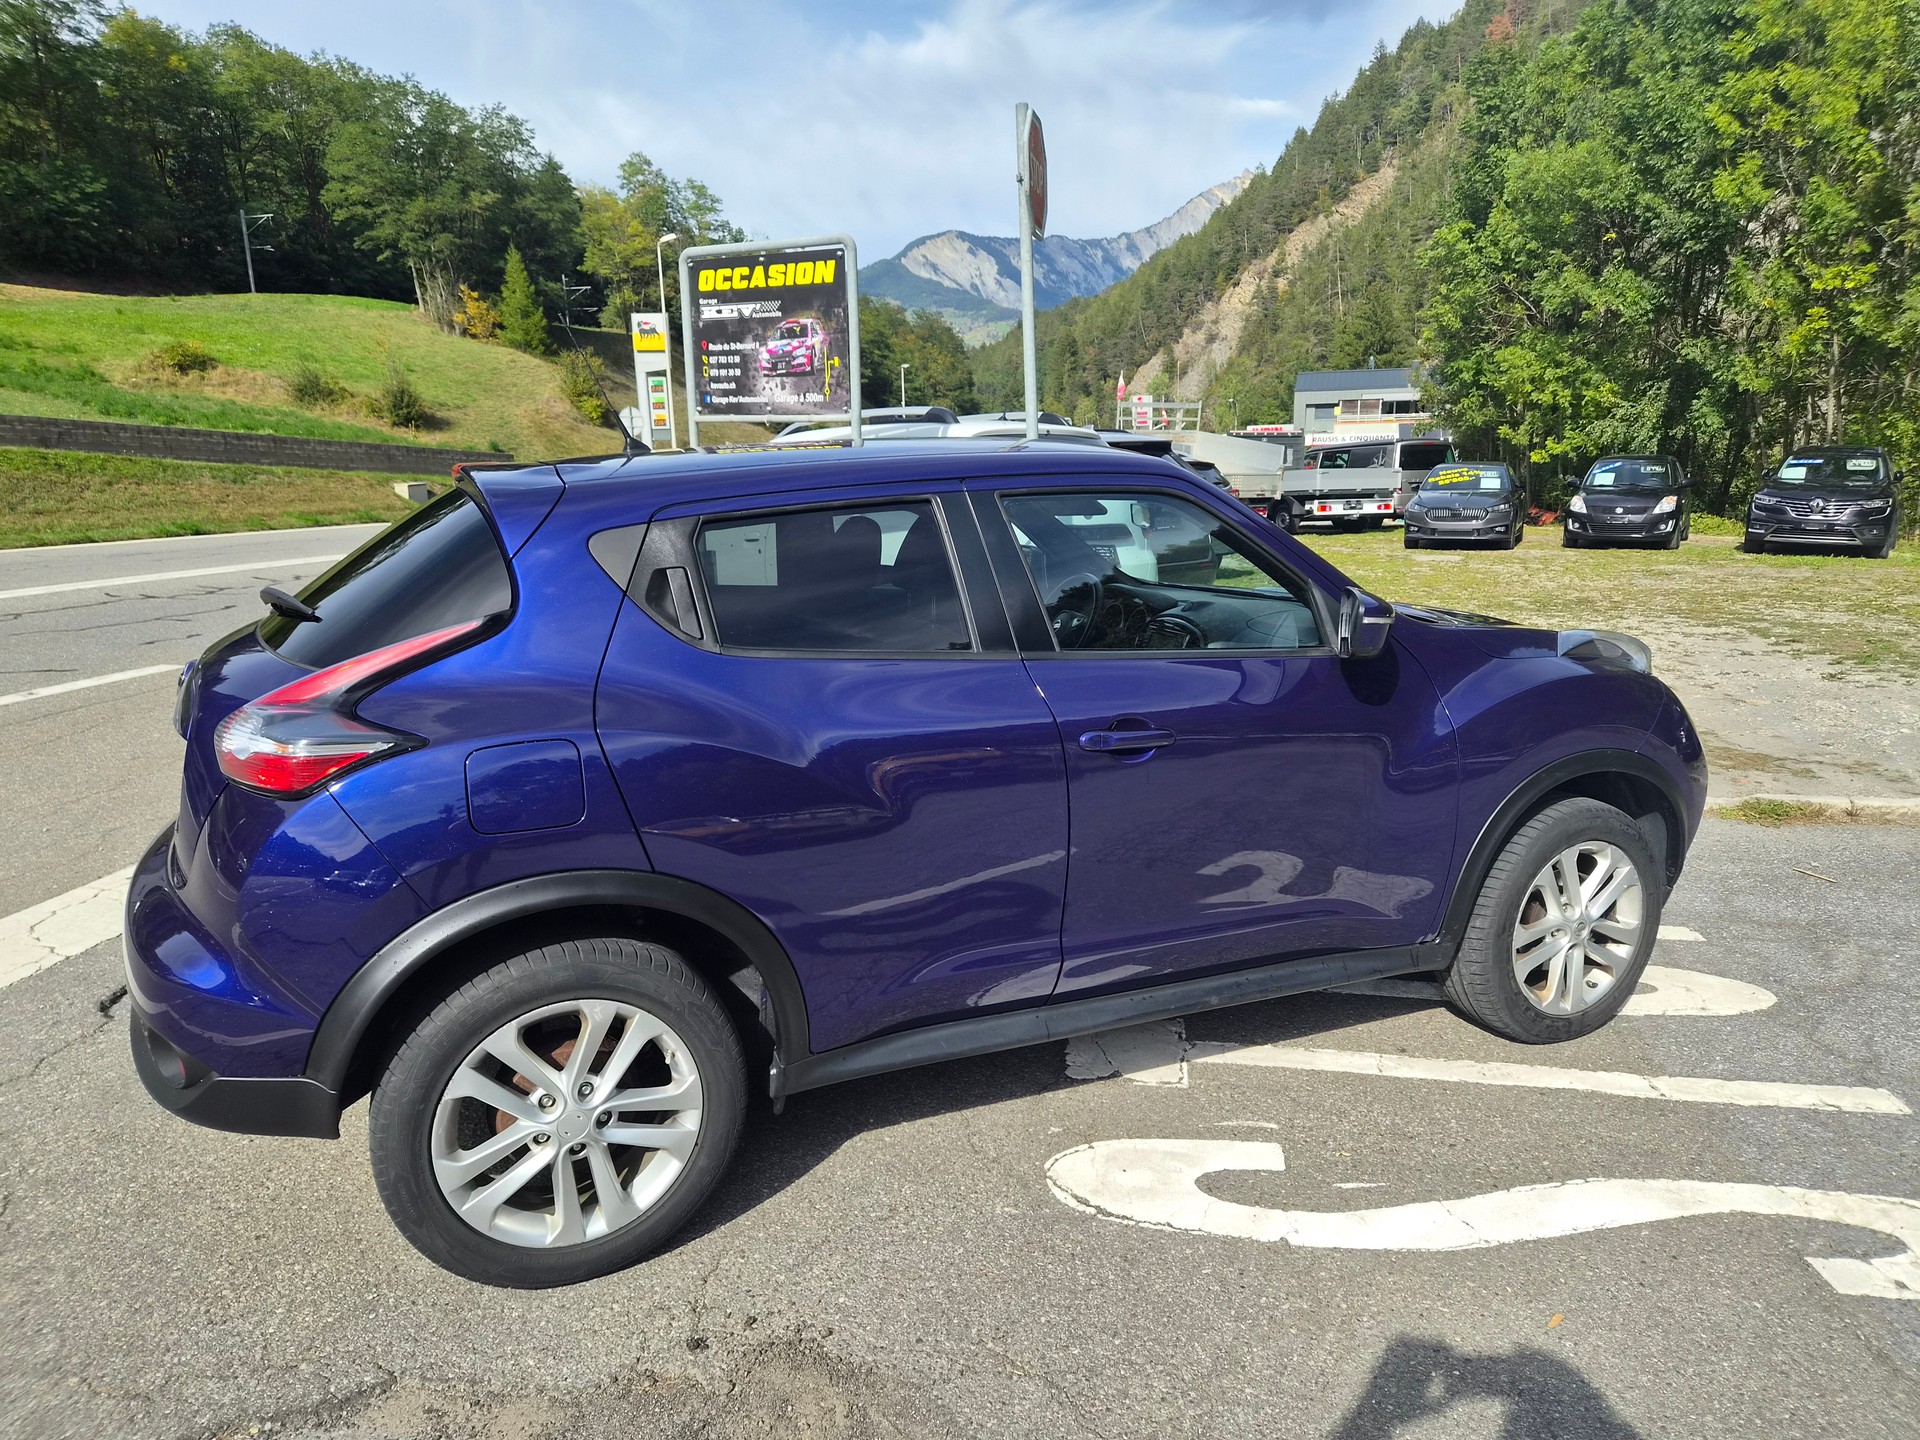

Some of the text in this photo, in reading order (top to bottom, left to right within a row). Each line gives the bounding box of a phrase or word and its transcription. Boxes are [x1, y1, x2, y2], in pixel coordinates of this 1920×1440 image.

[1030, 152, 1044, 197] STOP
[698, 259, 836, 292] OCCASION
[712, 396, 728, 405] Garage
[775, 394, 800, 404] Garage
[805, 393, 824, 402] 500m
[1350, 434, 1395, 442] CINQUANTA
